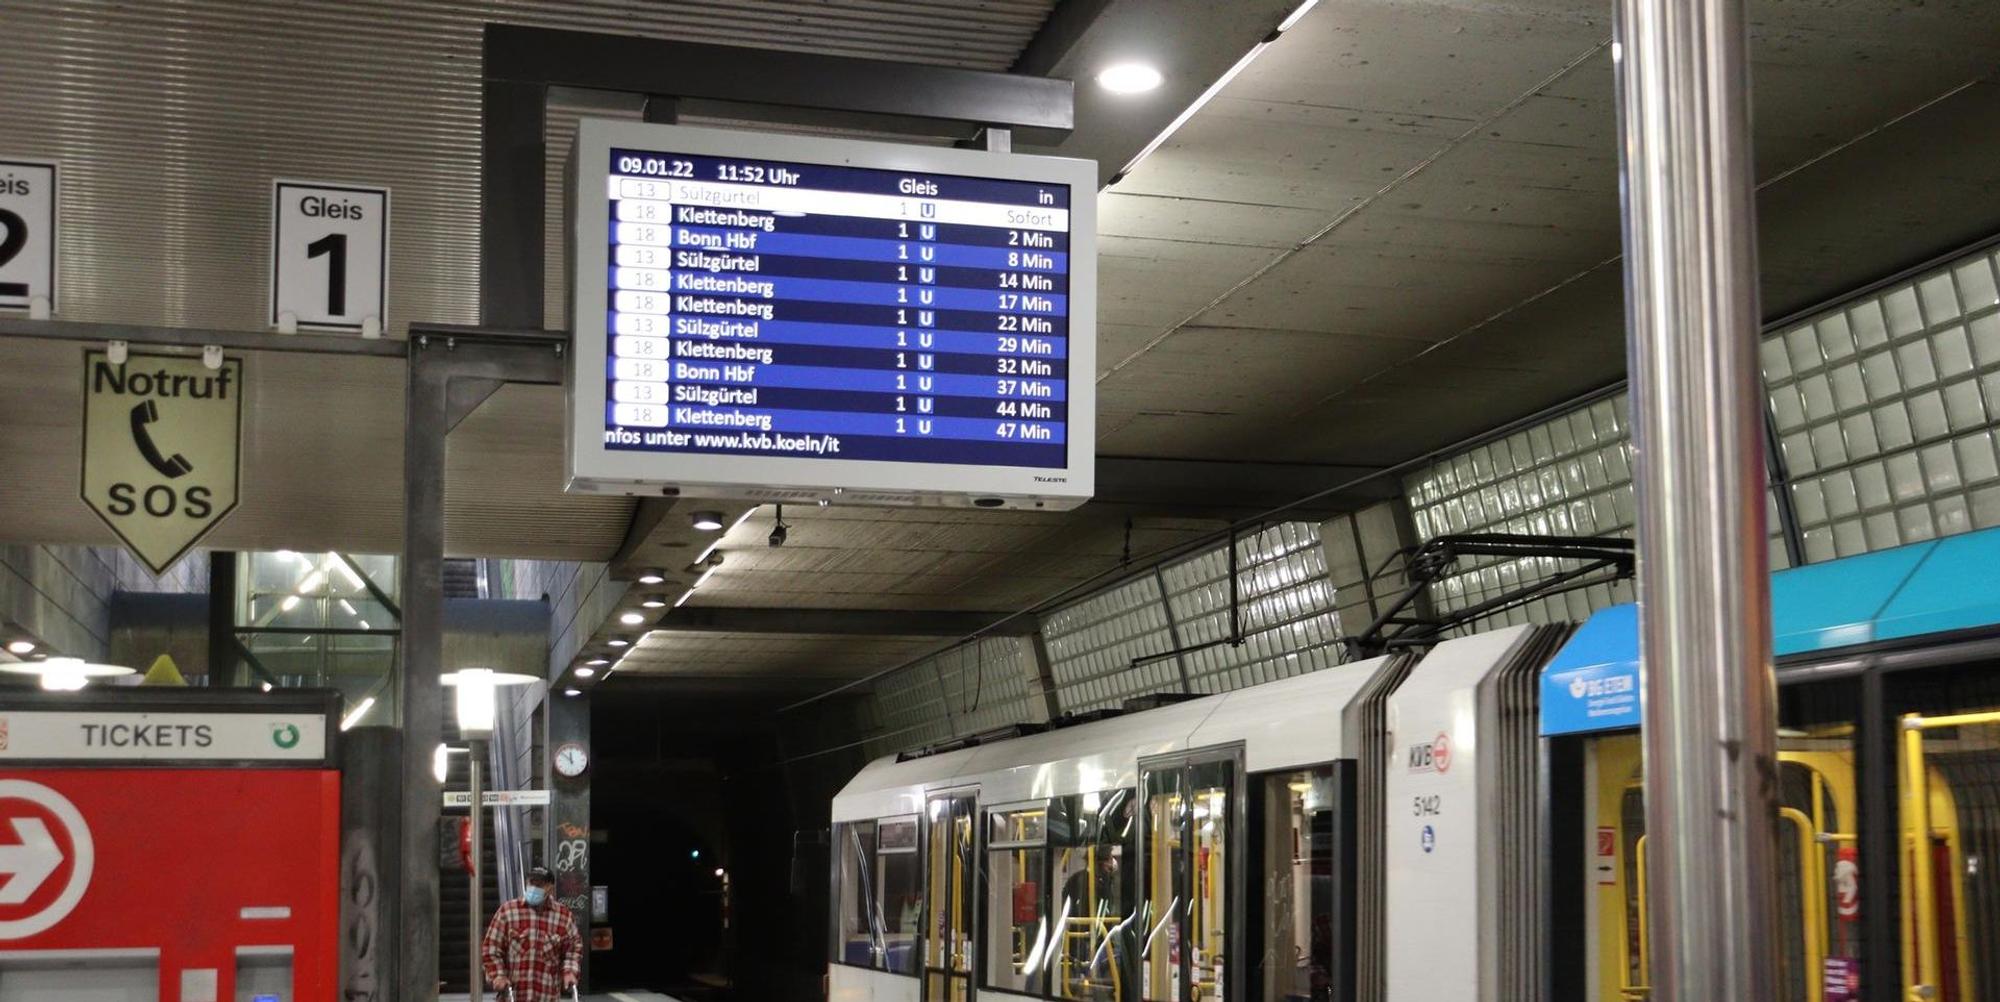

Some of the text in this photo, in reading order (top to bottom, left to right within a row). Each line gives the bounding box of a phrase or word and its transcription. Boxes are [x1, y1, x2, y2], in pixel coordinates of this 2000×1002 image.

[619, 157, 1054, 205] 09.01.22 11:52 Uhr Gleis in
[299, 195, 363, 221] Gleis
[901, 202, 907, 216] 1
[1007, 210, 1053, 226] Sofort
[678, 207, 775, 231] Klettenberg
[898, 223, 909, 237] 1
[1008, 231, 1018, 246] 2
[1023, 232, 1053, 248] Min
[678, 229, 722, 247] Bonn
[727, 231, 757, 249] Hbf
[898, 244, 908, 259] 1
[1008, 253, 1018, 267] 8
[1022, 253, 1053, 269] Min
[307, 233, 348, 317] 1
[677, 251, 760, 273] Sülzgürtel
[898, 266, 908, 281] 1
[999, 273, 1018, 288] 14
[1022, 274, 1052, 290] Min
[677, 274, 774, 297] Klettenberg
[898, 288, 908, 302] 1
[999, 295, 1017, 310] 17
[1022, 296, 1052, 312] Min
[677, 297, 774, 320] Klettenberg
[897, 309, 907, 324] 1
[998, 316, 1017, 331] 22
[1022, 317, 1051, 333] Min
[677, 319, 759, 339] Sülzgürtel
[897, 331, 907, 346] 1
[998, 337, 1017, 352] 29
[1021, 339, 1051, 354] Min
[676, 341, 773, 364] Klettenberg
[897, 353, 907, 367] 1
[997, 359, 1016, 374] 32
[1021, 360, 1051, 376] Min
[94, 361, 232, 400] Notruf
[676, 363, 719, 380] Bonn
[725, 366, 755, 382] Hbf
[896, 375, 906, 389] 1
[997, 380, 1016, 395] 37
[1021, 382, 1051, 397] Min
[676, 385, 758, 406] Sülzgürtel
[896, 397, 906, 412] 1
[996, 402, 1016, 417] 44
[1021, 403, 1051, 419] Min
[605, 428, 840, 453] nfos unter www.kvb.koeln/it
[676, 408, 772, 430] Klettenberg
[896, 418, 906, 433] 1
[996, 423, 1016, 438] 47
[1020, 424, 1050, 440] Min
[1034, 476, 1067, 484] TELESTE
[107, 482, 213, 519] SOS
[81, 723, 213, 747] TICKETS
[1413, 795, 1441, 817] 5142
